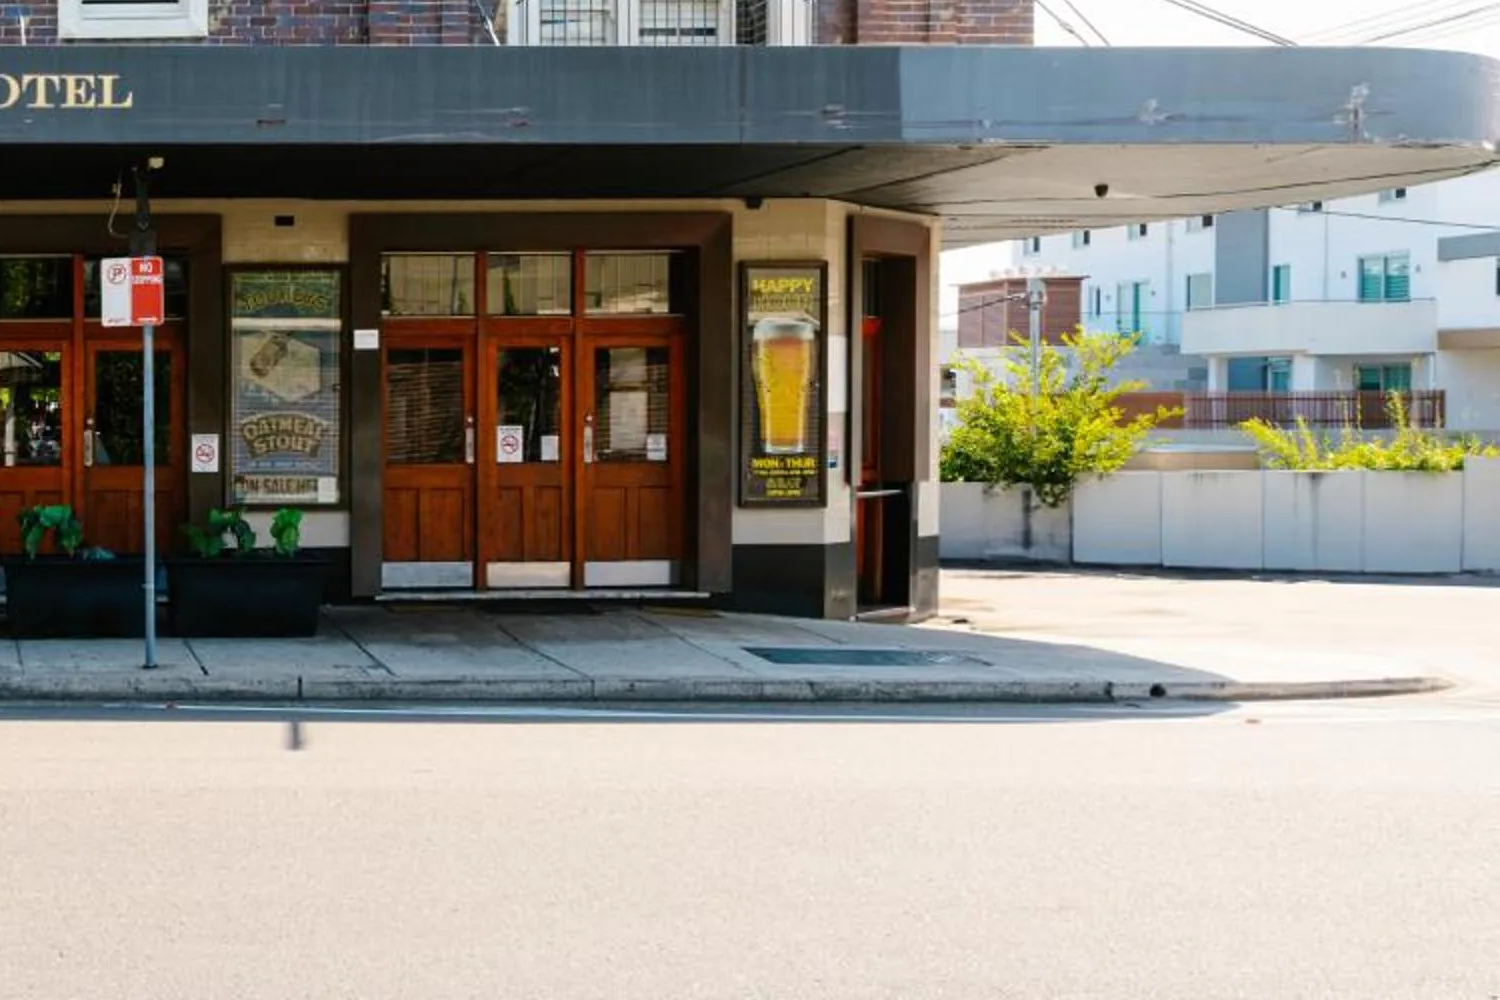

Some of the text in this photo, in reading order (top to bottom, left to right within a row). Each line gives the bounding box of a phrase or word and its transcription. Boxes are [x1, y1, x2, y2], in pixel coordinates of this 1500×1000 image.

[138, 261, 154, 274] NO
[751, 278, 814, 294] HAPPY
[243, 417, 326, 441] OATMEAL
[253, 434, 314, 454] STOUT
